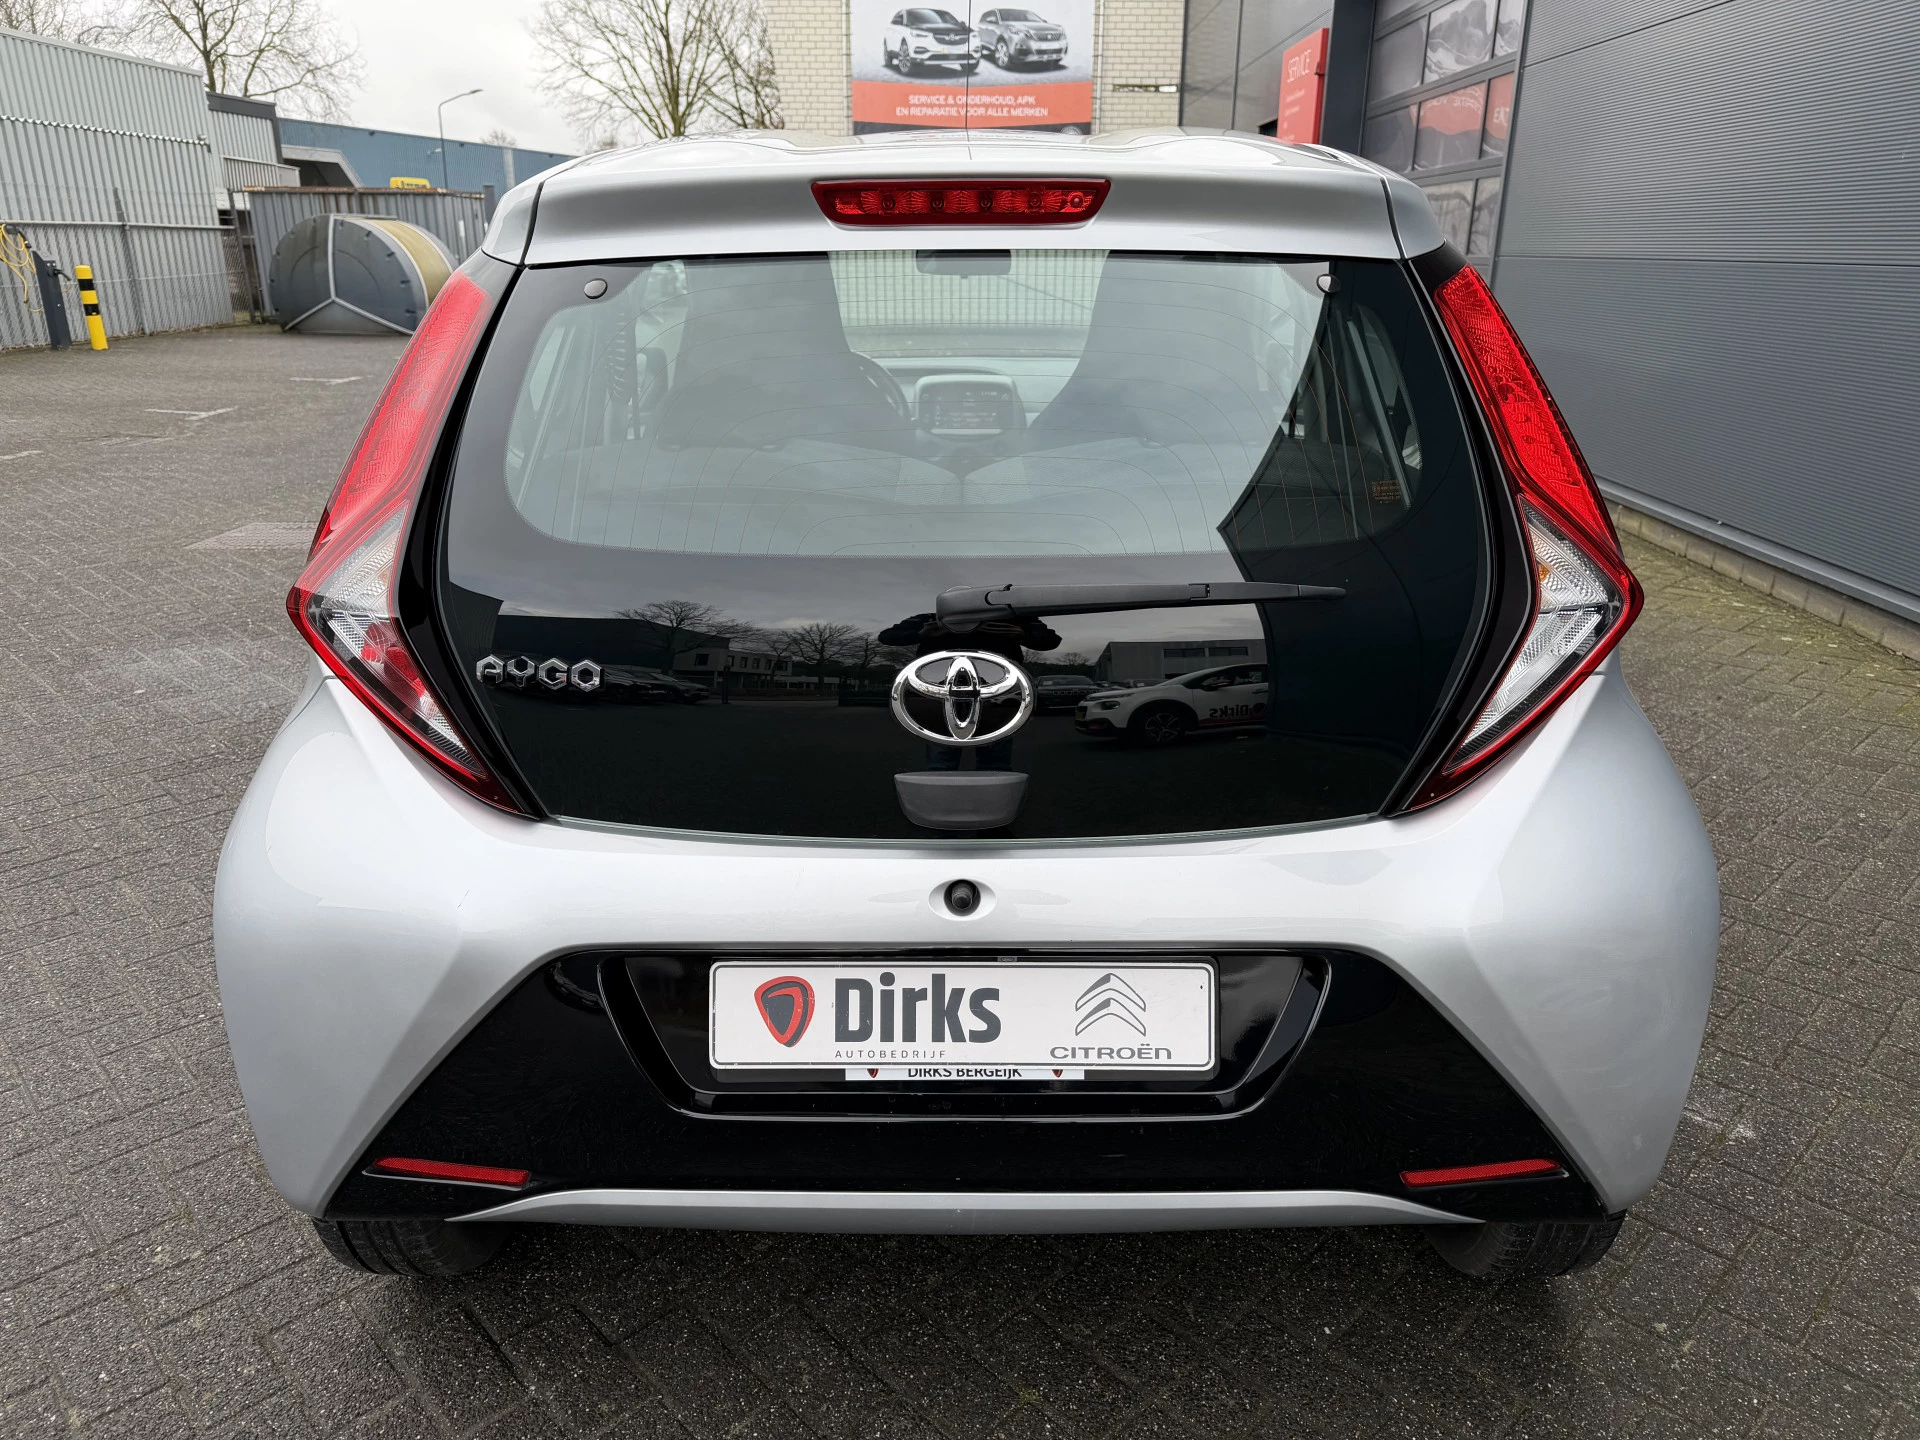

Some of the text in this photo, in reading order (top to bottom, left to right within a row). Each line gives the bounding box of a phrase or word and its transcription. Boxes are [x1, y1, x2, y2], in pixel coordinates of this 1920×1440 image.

[1287, 49, 1312, 83] SERVICE
[908, 95, 1036, 105] SERVICE & ONDERHOUD, APK
[895, 107, 909, 116] EN
[910, 107, 958, 116] REPARATIE
[959, 107, 985, 116] VOOR
[987, 107, 1009, 116] ALLE
[475, 653, 601, 693] AYGO
[834, 971, 1001, 1043] Dirks
[834, 1050, 946, 1059] AUTOBEDRIJF
[1049, 1043, 1172, 1060] CITROËN
[908, 1067, 1022, 1079] DIRKS BERGEIJK
